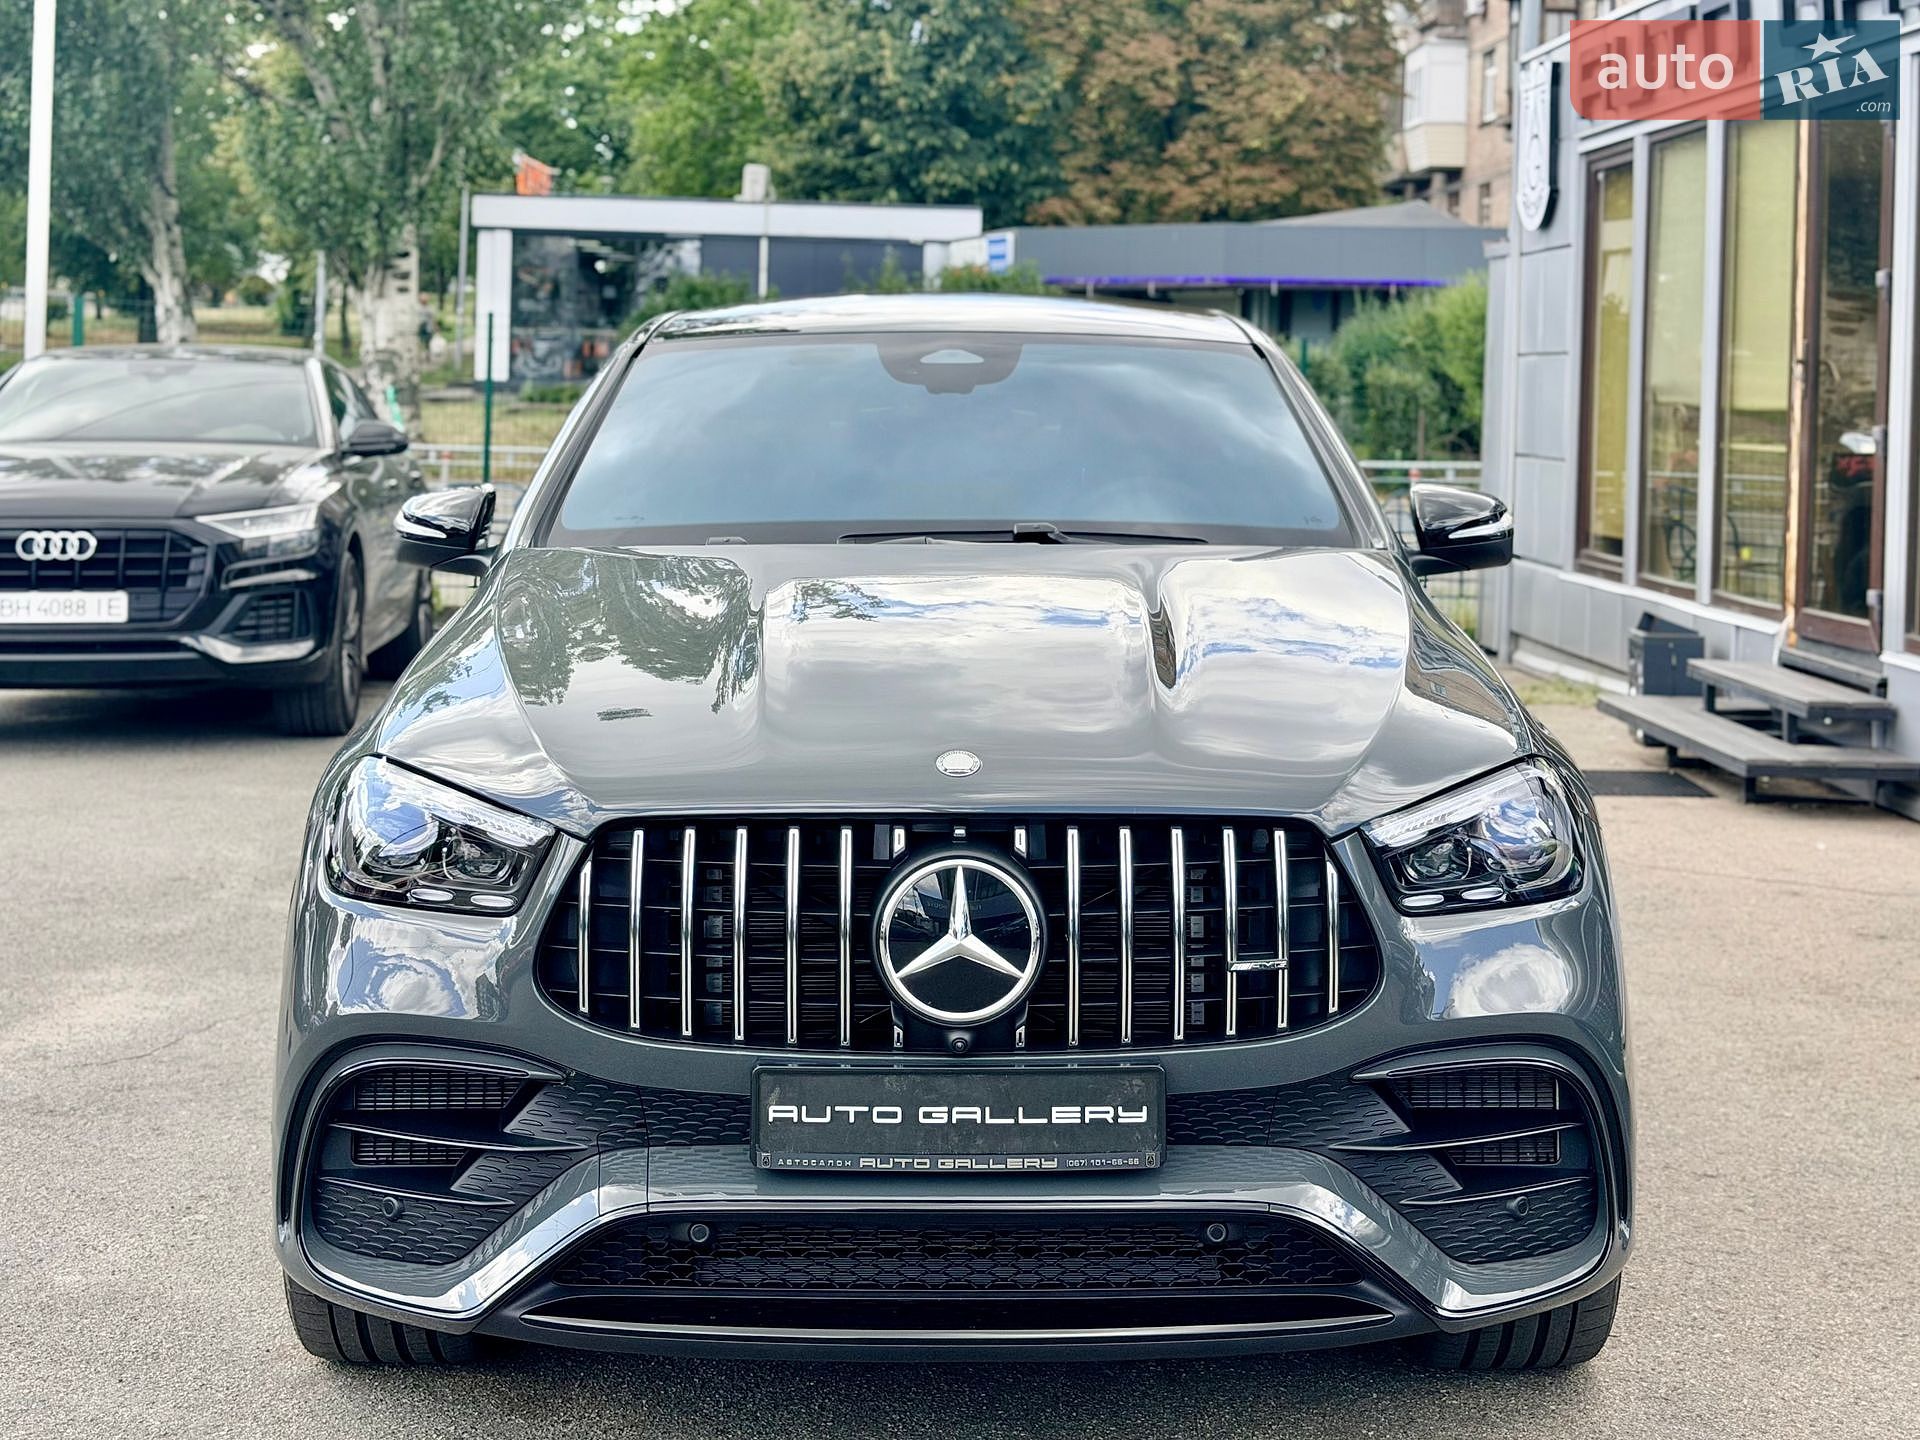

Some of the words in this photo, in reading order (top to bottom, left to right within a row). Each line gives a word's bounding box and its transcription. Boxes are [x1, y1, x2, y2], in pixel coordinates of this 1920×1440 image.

[37, 598, 87, 617] 4088
[767, 1105, 903, 1124] AUTO
[918, 1105, 1148, 1125] GALLERY
[859, 1157, 931, 1169] AUTO
[937, 1157, 1058, 1169] GALLERY
